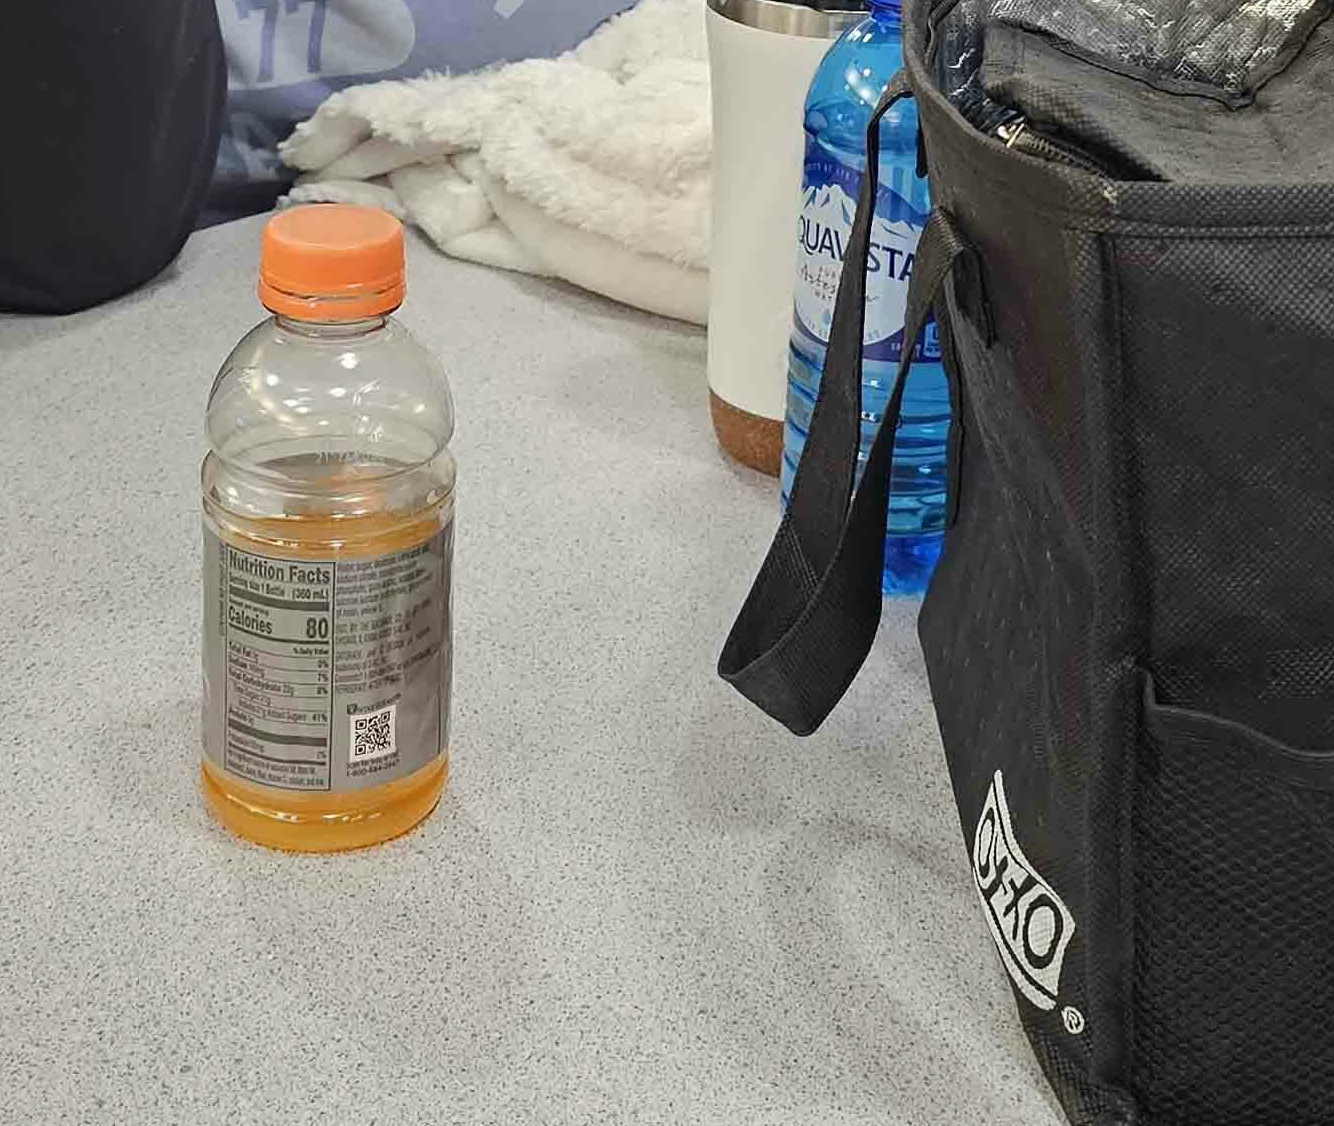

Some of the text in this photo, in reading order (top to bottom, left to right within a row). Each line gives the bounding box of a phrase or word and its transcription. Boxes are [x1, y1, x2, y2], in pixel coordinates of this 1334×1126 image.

[229, 550, 331, 584] Nutrition Facts
[228, 605, 273, 635] Calories
[306, 617, 329, 639] 80
